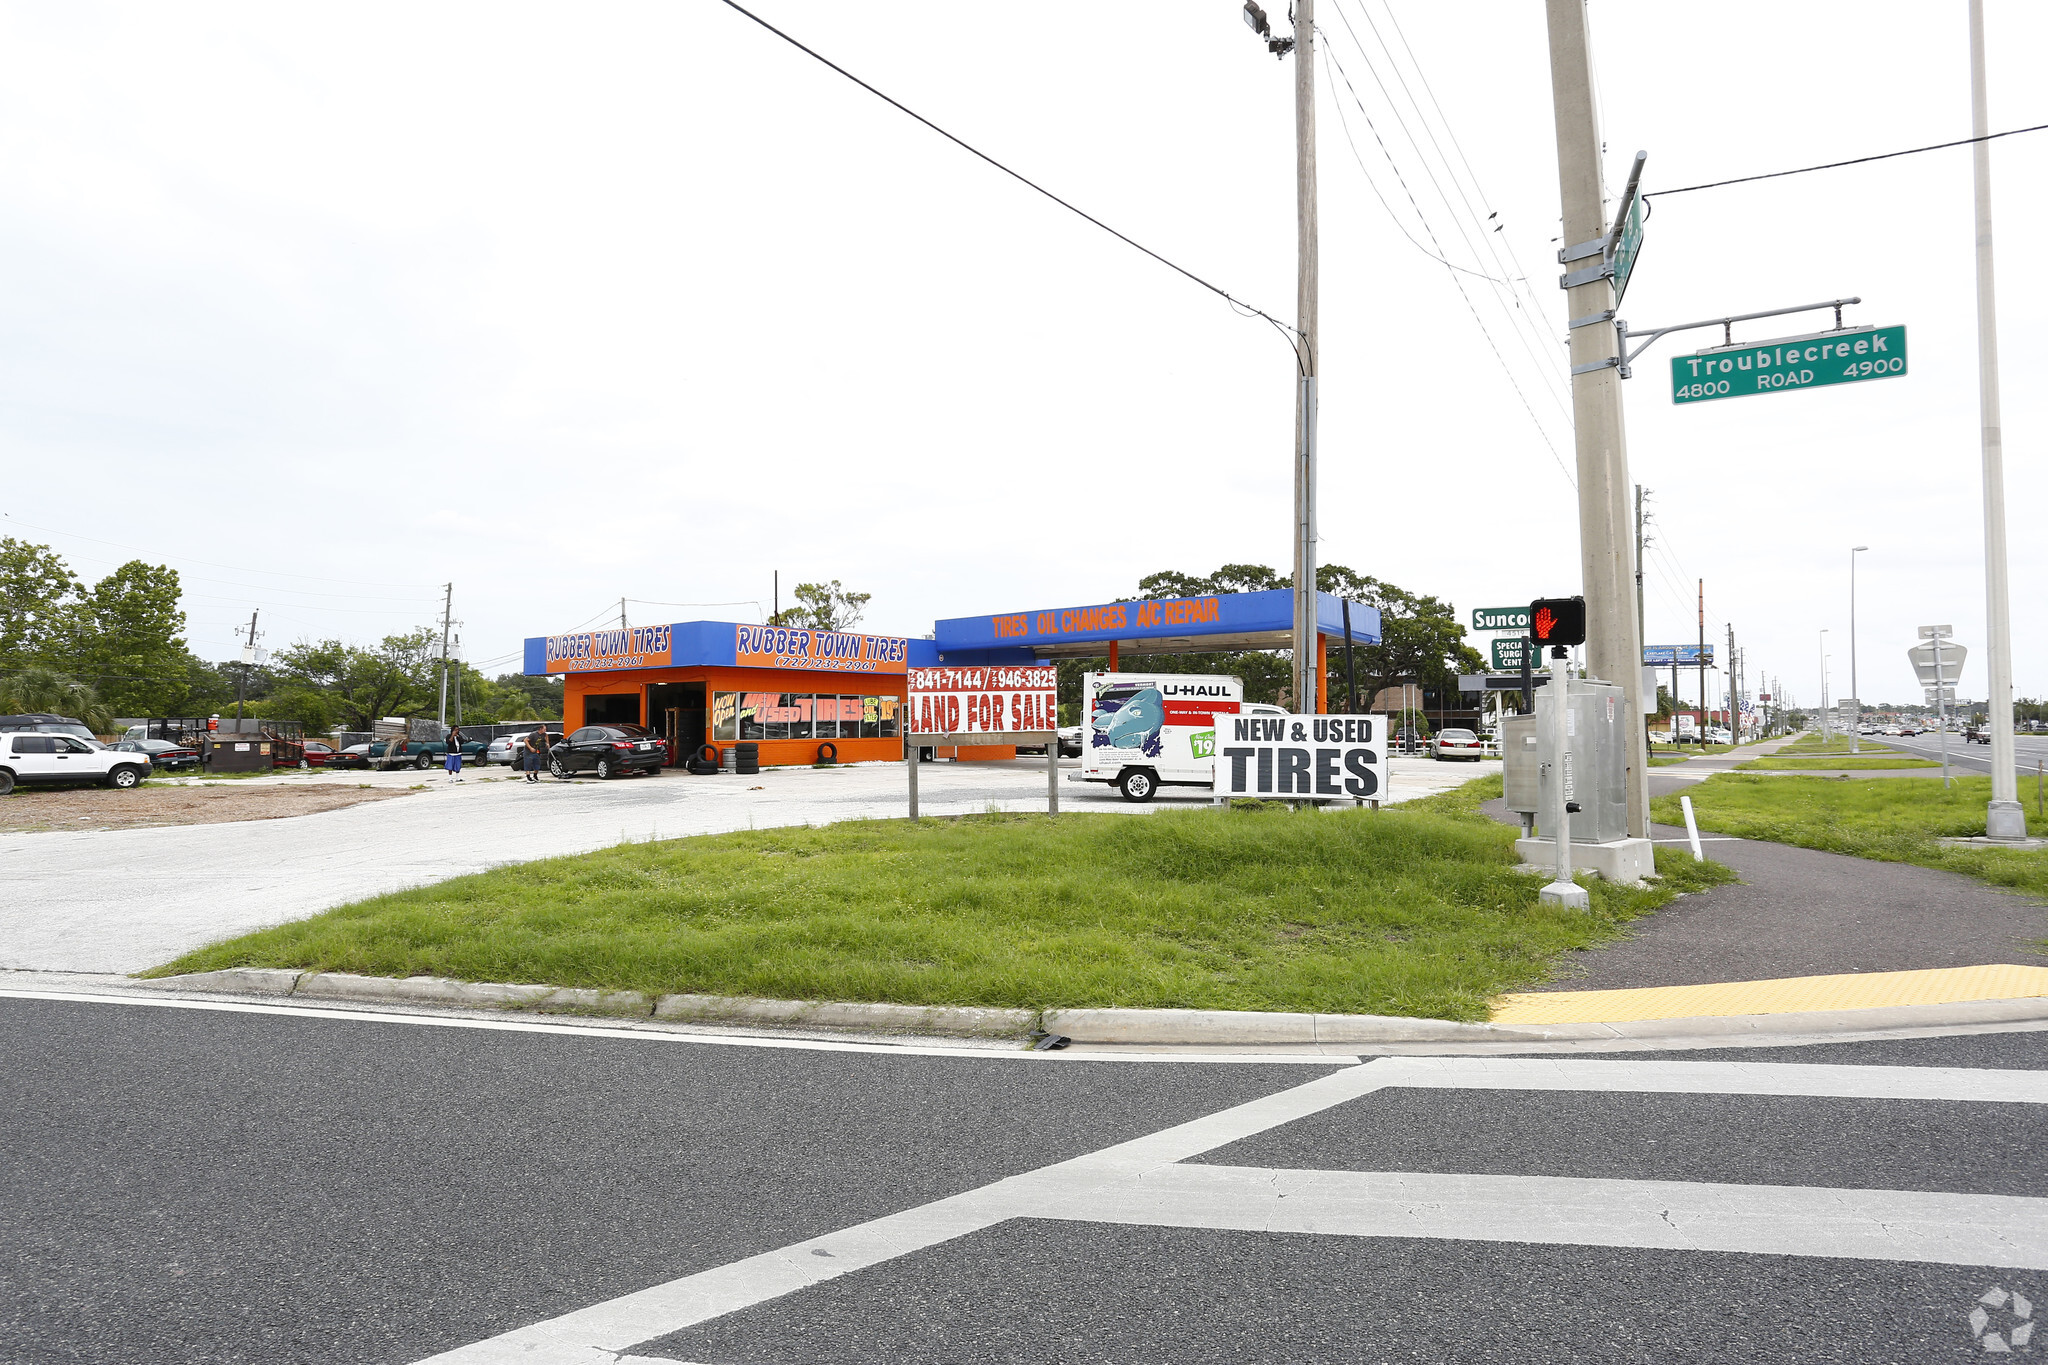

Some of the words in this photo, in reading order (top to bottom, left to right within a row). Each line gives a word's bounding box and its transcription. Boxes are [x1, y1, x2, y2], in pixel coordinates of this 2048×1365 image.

[1687, 334, 1888, 377] Troublecreek
[1676, 380, 1731, 399] 4800
[1757, 369, 1814, 390] ROAD
[1843, 357, 1904, 377] 4900
[992, 614, 1028, 638] TIRES
[1037, 612, 1058, 635] OIL
[1061, 605, 1127, 633] CHANGES
[1136, 600, 1161, 628] A/C
[1164, 597, 1220, 625] REPAIR
[547, 634, 591, 663] RUBBER
[595, 629, 630, 657] TOWN
[633, 625, 671, 655] TIRES
[737, 626, 811, 658] RUBBER
[815, 631, 862, 660] TOWN
[865, 637, 906, 663] TIRES
[1498, 650, 1534, 658] SURGY
[568, 656, 644, 670] (727)232-2961
[774, 656, 877, 671] (727)232-2961
[998, 669, 1057, 688] 946-3825
[1163, 684, 1232, 697] U-HAUL
[715, 693, 736, 710] NOW
[740, 704, 758, 719] and
[753, 707, 801, 723] USED
[794, 698, 864, 722] TIRES
[741, 693, 781, 708] NEW
[864, 706, 877, 714] OIL
[714, 705, 736, 728] Open
[910, 695, 960, 733] LAND
[967, 693, 1004, 732] FOR
[1011, 693, 1056, 731] SALE
[1234, 718, 1286, 741] NEW
[1290, 722, 1307, 742] &
[1313, 719, 1372, 743] USED
[1223, 747, 1378, 796] TIRES
